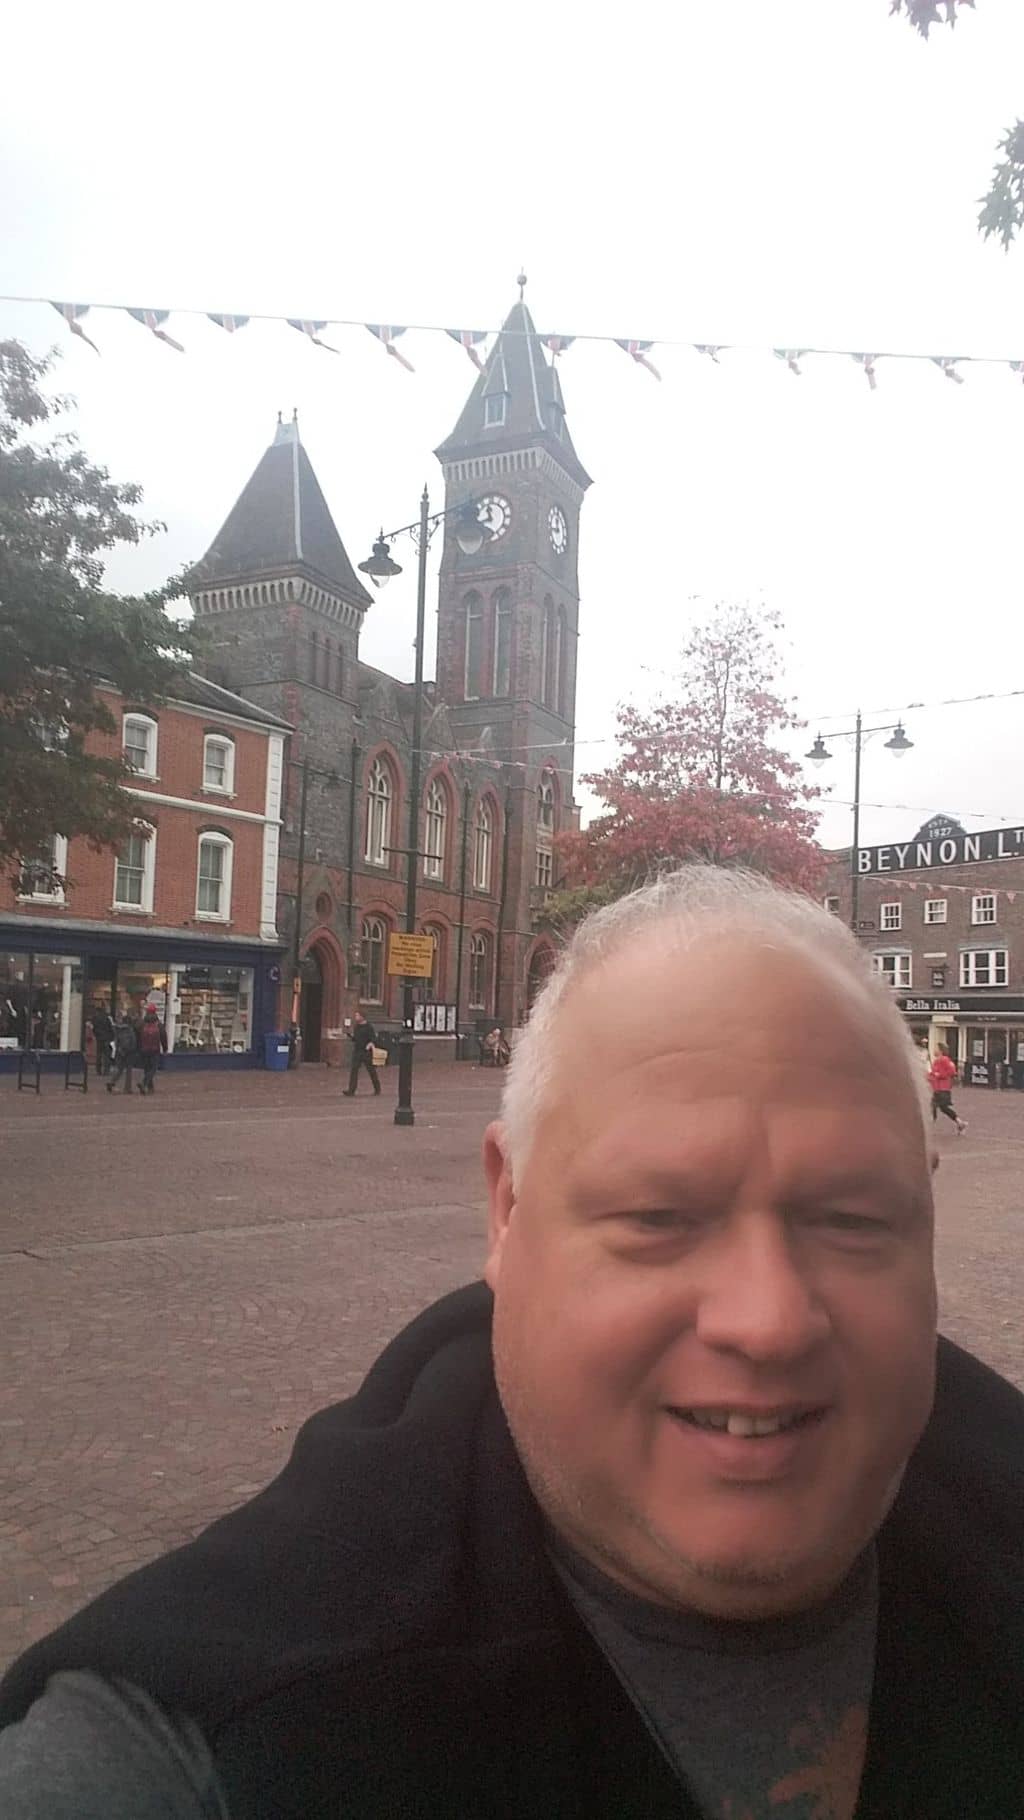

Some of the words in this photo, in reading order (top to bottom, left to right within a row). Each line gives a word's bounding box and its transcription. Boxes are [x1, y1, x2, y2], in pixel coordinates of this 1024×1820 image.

[929, 827, 952, 838] 1927
[906, 1000, 930, 1010] Bella
[934, 1000, 960, 1010] Italia
